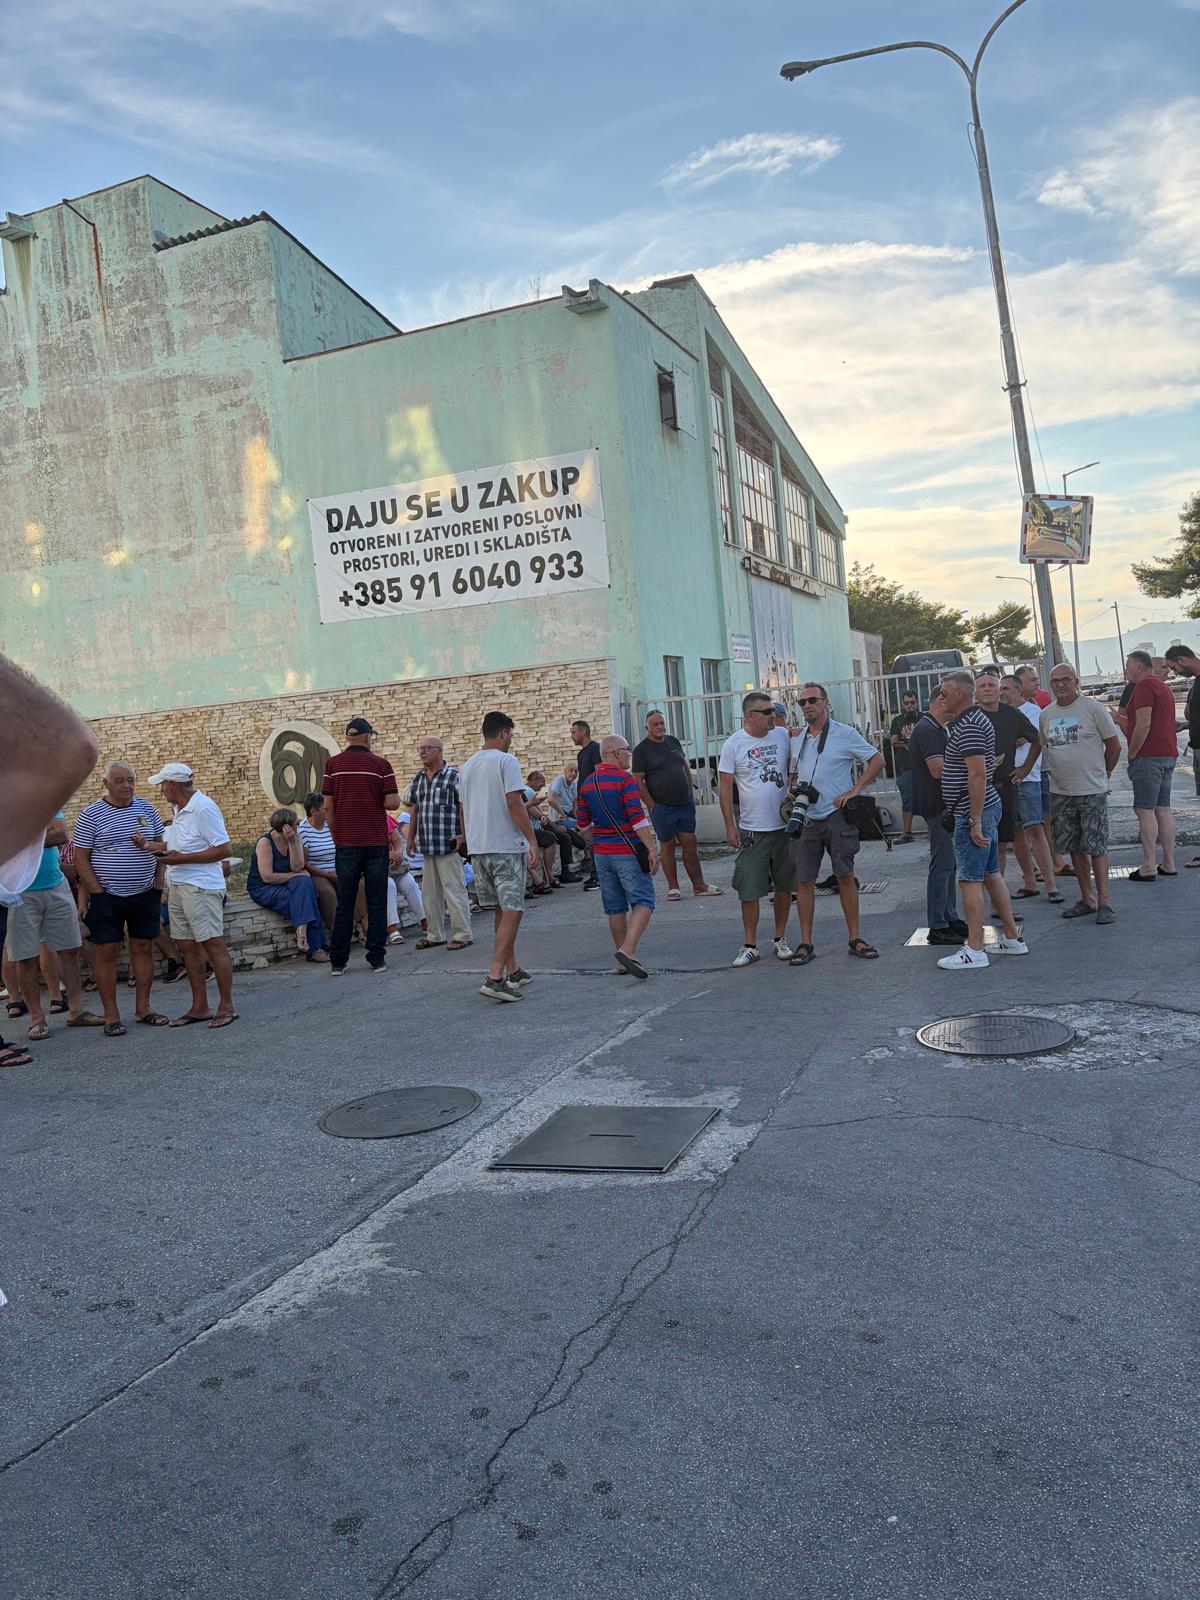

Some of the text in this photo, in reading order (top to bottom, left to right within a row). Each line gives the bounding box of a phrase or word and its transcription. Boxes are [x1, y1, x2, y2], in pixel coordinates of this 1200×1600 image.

[326, 466, 580, 533] DAJU SE U ZAKUP
[330, 504, 582, 555] OTVORENI I ZATVORENI POSLOVNI
[343, 525, 572, 573] PROSTORI, UREDI I SKLADIŠTA
[339, 551, 584, 607] +385 91 6040 933
